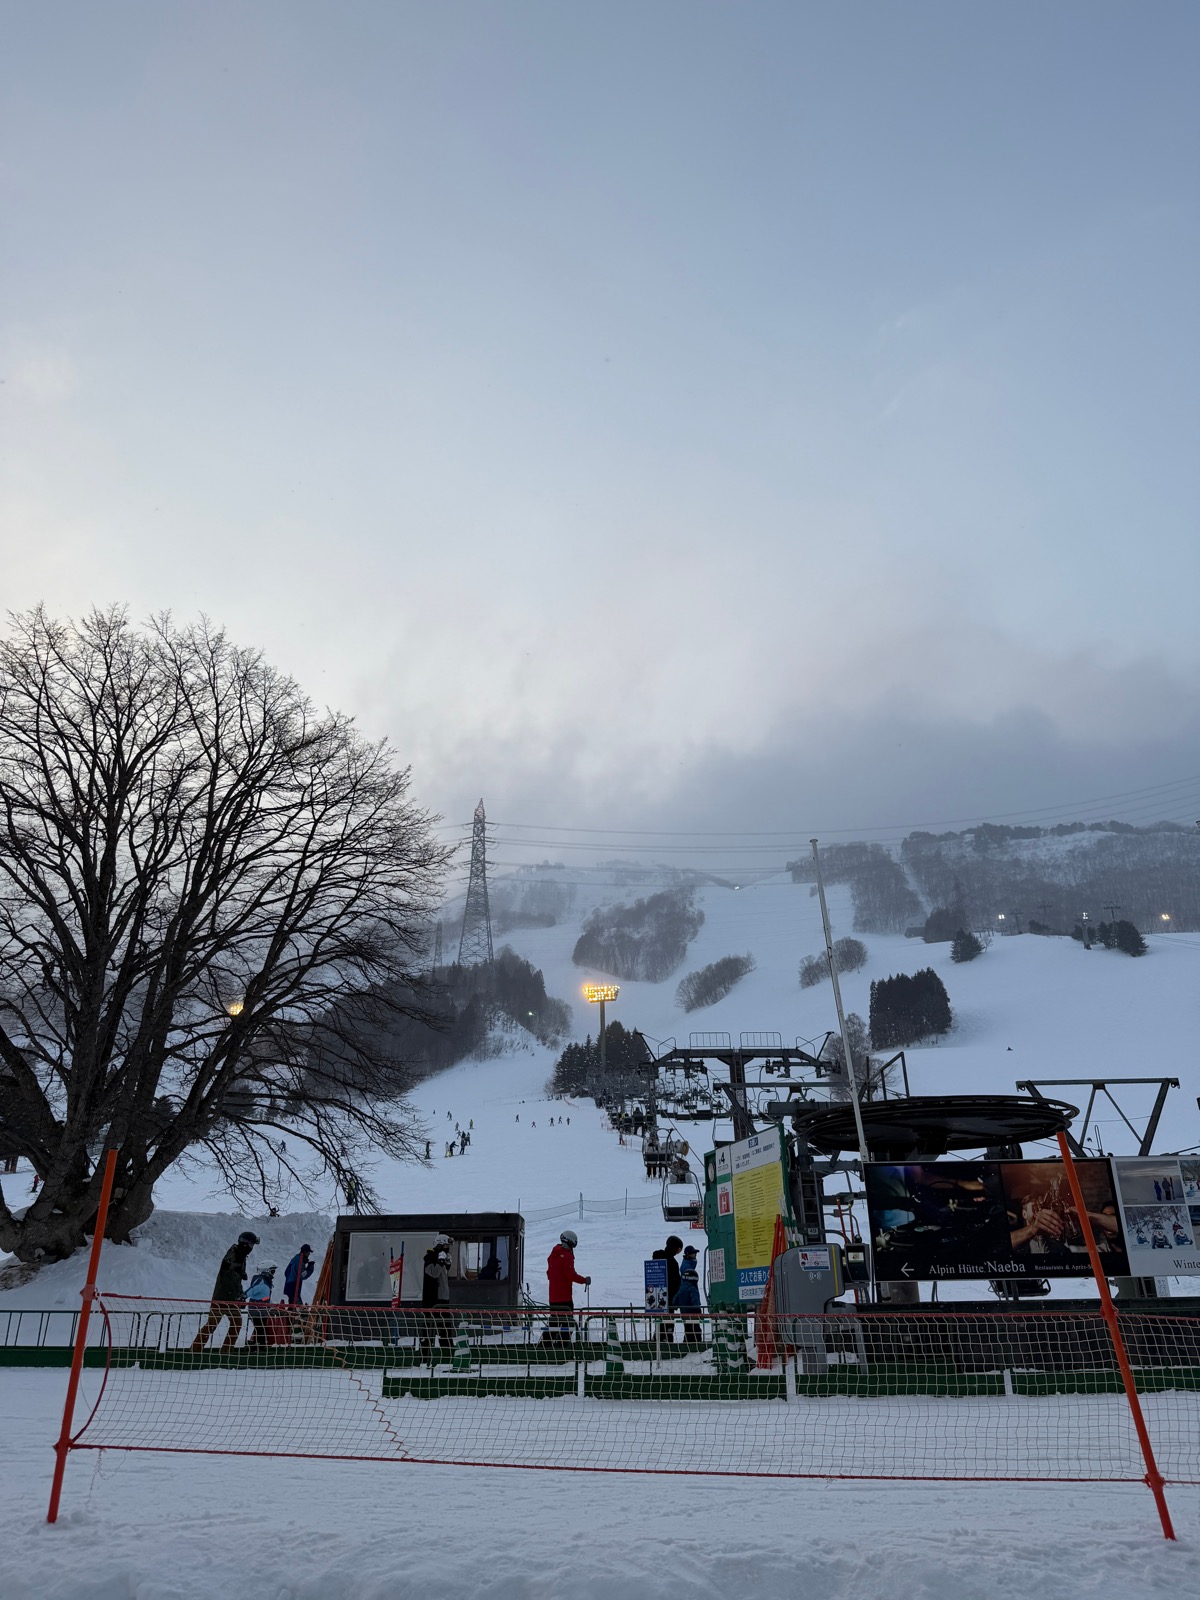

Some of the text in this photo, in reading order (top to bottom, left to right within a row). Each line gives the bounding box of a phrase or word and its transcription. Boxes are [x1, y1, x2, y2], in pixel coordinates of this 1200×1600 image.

[928, 1264, 956, 1277] Alpin
[958, 1263, 985, 1274] Hütte
[986, 1260, 1026, 1273] Naeba
[1071, 1263, 1093, 1271] Après-S
